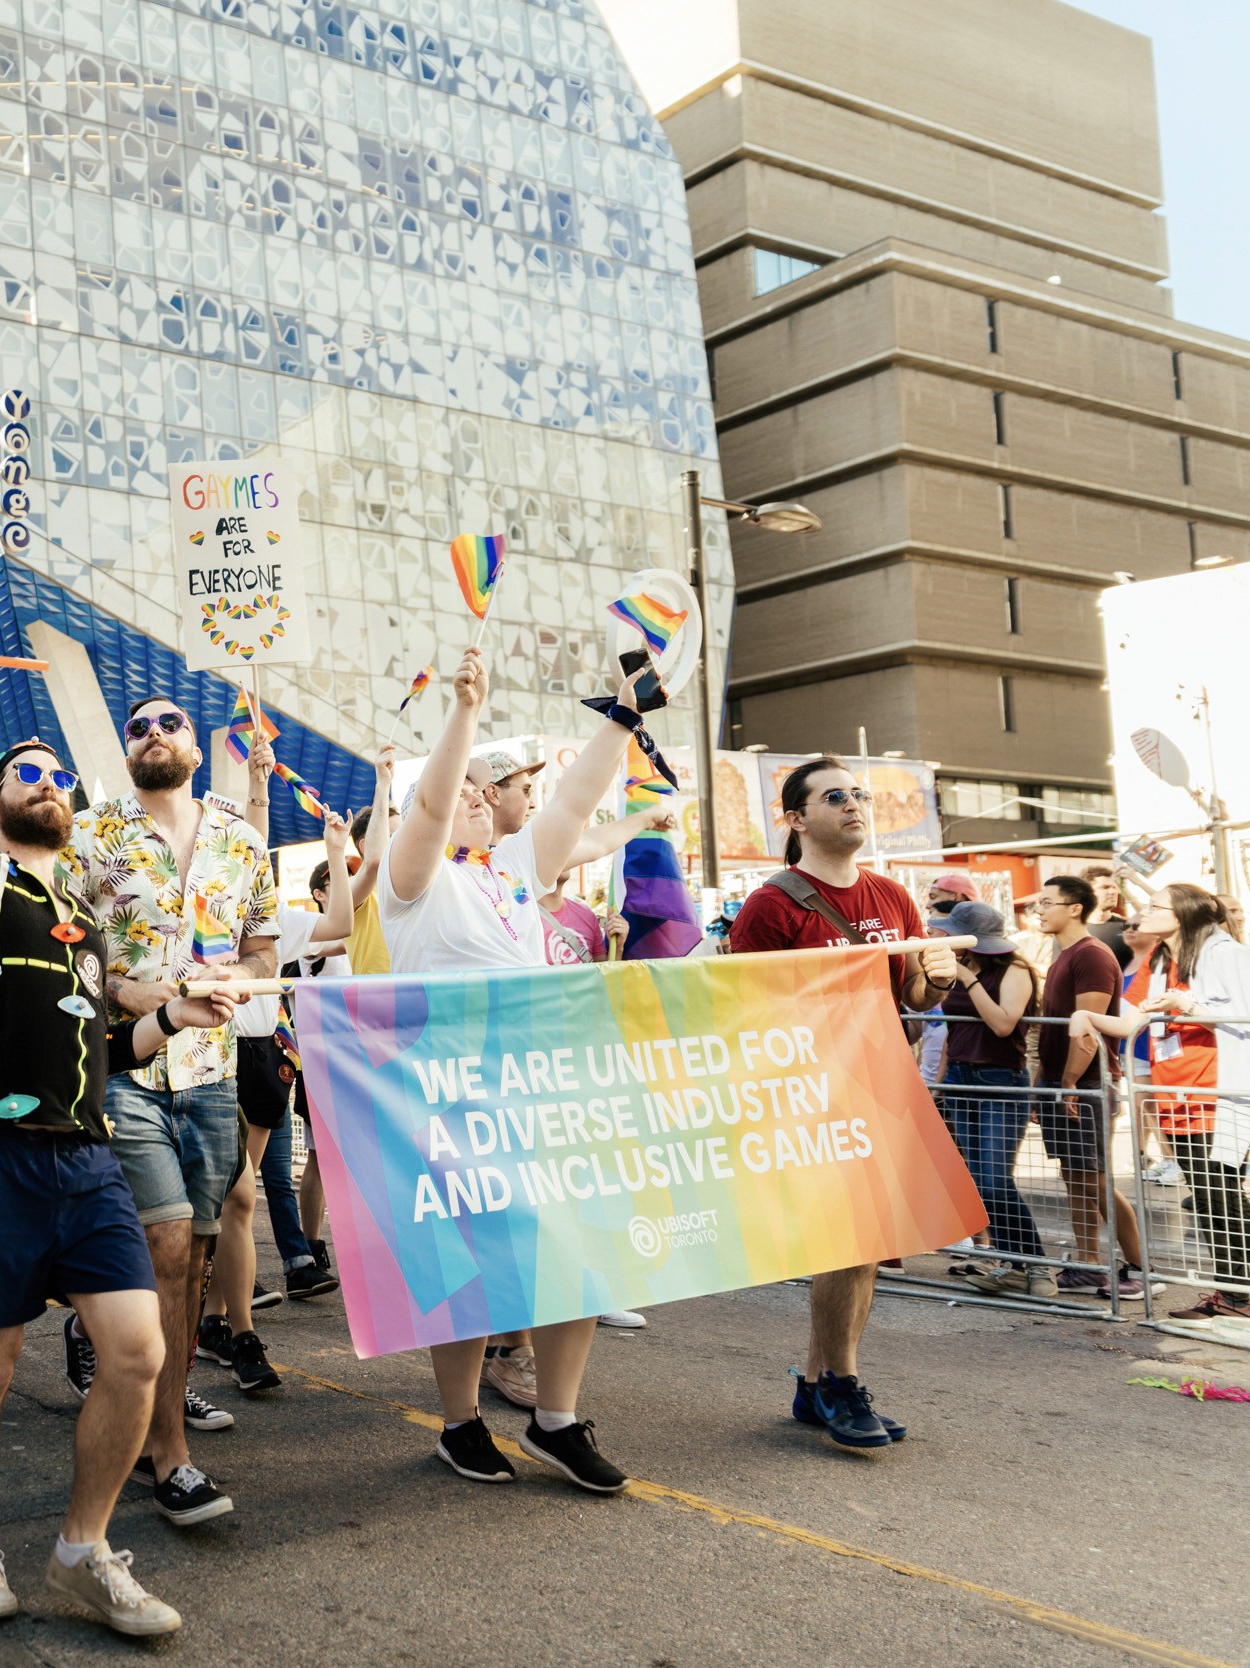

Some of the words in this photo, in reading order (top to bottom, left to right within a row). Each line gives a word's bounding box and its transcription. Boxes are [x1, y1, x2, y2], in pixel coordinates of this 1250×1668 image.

[182, 472, 280, 510] GAYMES
[215, 516, 249, 536] ARE
[223, 539, 255, 558] FOR
[188, 564, 283, 596] EVERYONE
[859, 918, 883, 932] ARE
[412, 1056, 489, 1104] WE
[500, 1048, 580, 1097] ARE
[586, 1034, 731, 1087] UNITED
[738, 1026, 819, 1071] FOR
[429, 1115, 461, 1162] A
[465, 1095, 640, 1156] DIVERSE
[642, 1072, 829, 1135] INDUSTRY
[413, 1166, 513, 1223] AND
[517, 1136, 735, 1206] INCLUSIVE
[739, 1117, 873, 1174] GAMES
[657, 1209, 718, 1234] UBISOFT
[663, 1229, 718, 1249] TORONTO
